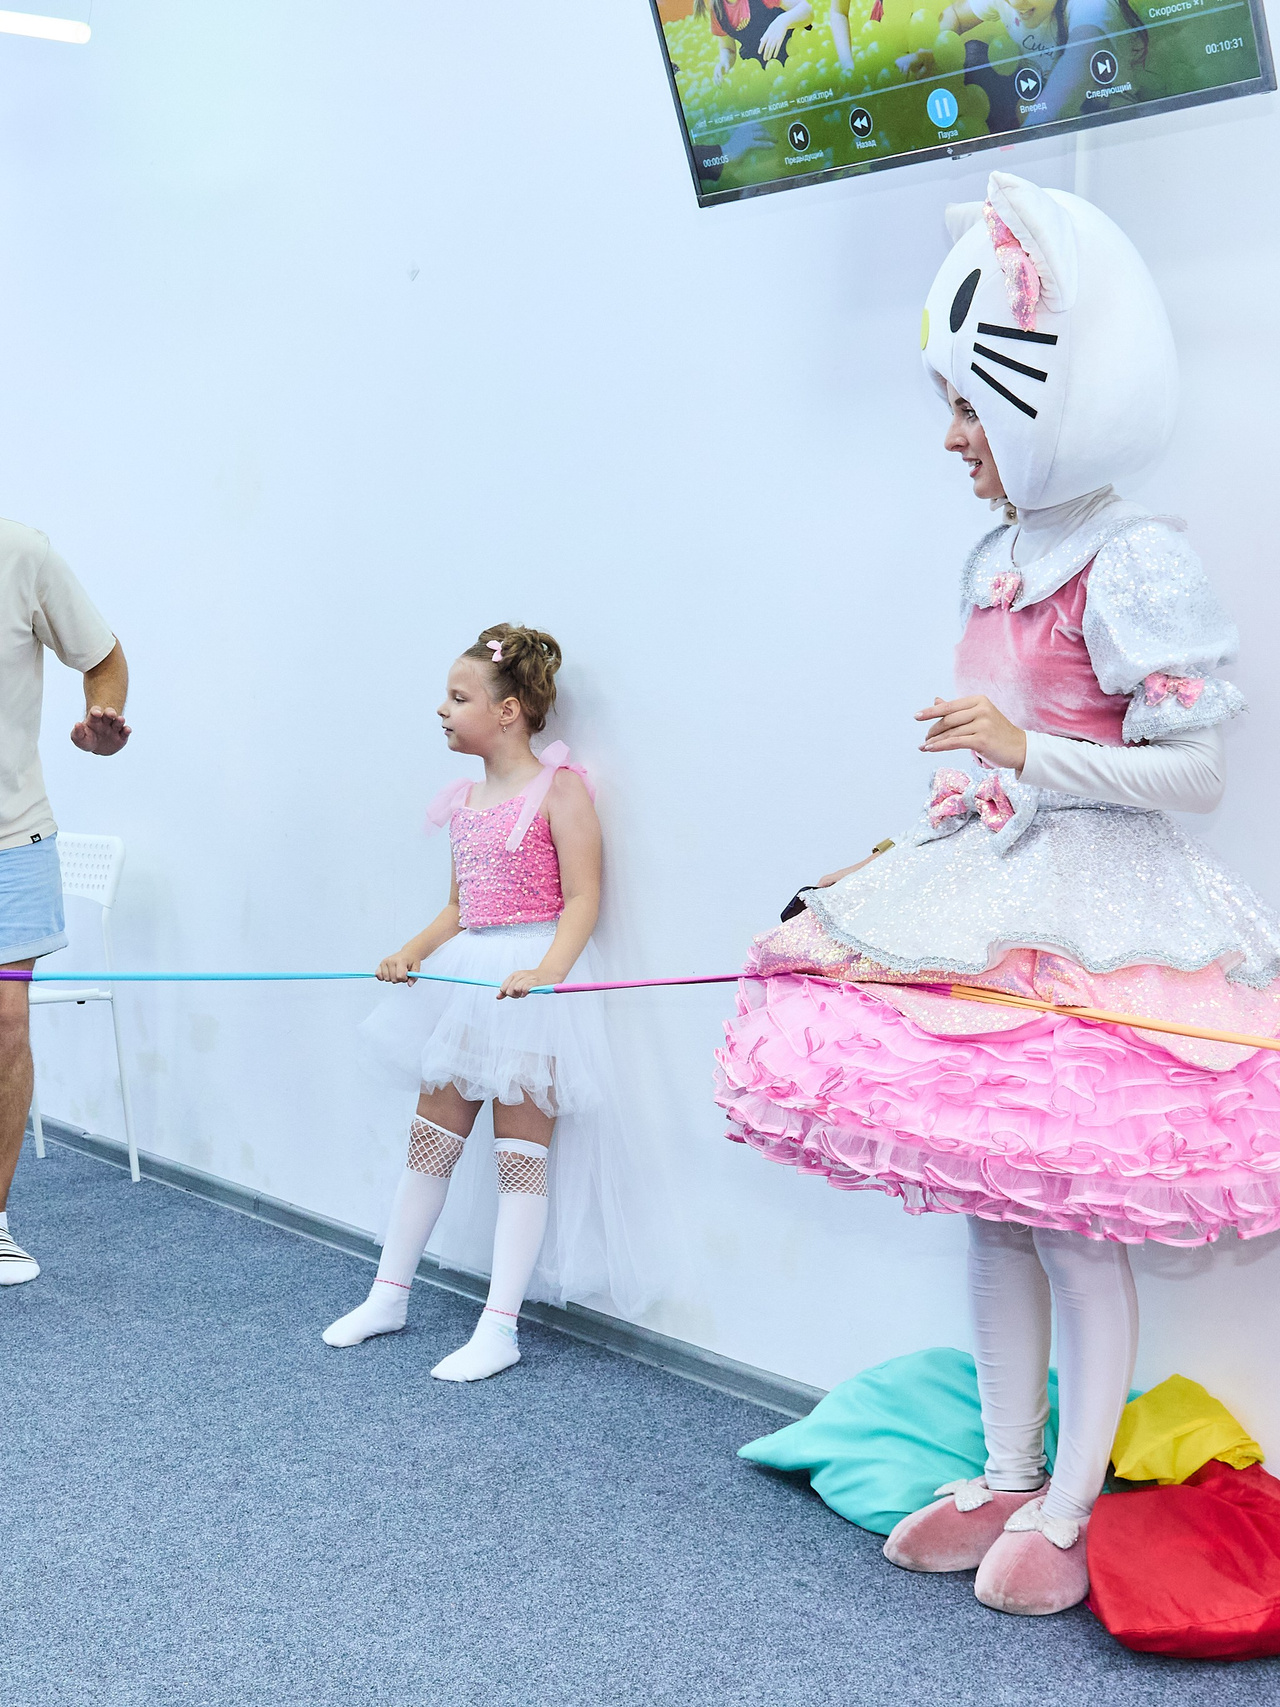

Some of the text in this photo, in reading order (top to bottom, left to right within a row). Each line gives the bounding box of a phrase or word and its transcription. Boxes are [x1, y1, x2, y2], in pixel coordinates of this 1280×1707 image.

[1148, 1, 1192, 18] Скорость
[1205, 37, 1244, 55] 00:10:31
[1085, 82, 1132, 100] Следующий
[1019, 101, 1048, 114] Вперед
[937, 128, 959, 141] Пауза
[856, 138, 877, 150] Назад
[702, 154, 730, 168] 00:00:05
[784, 149, 825, 166] Предыдущий
